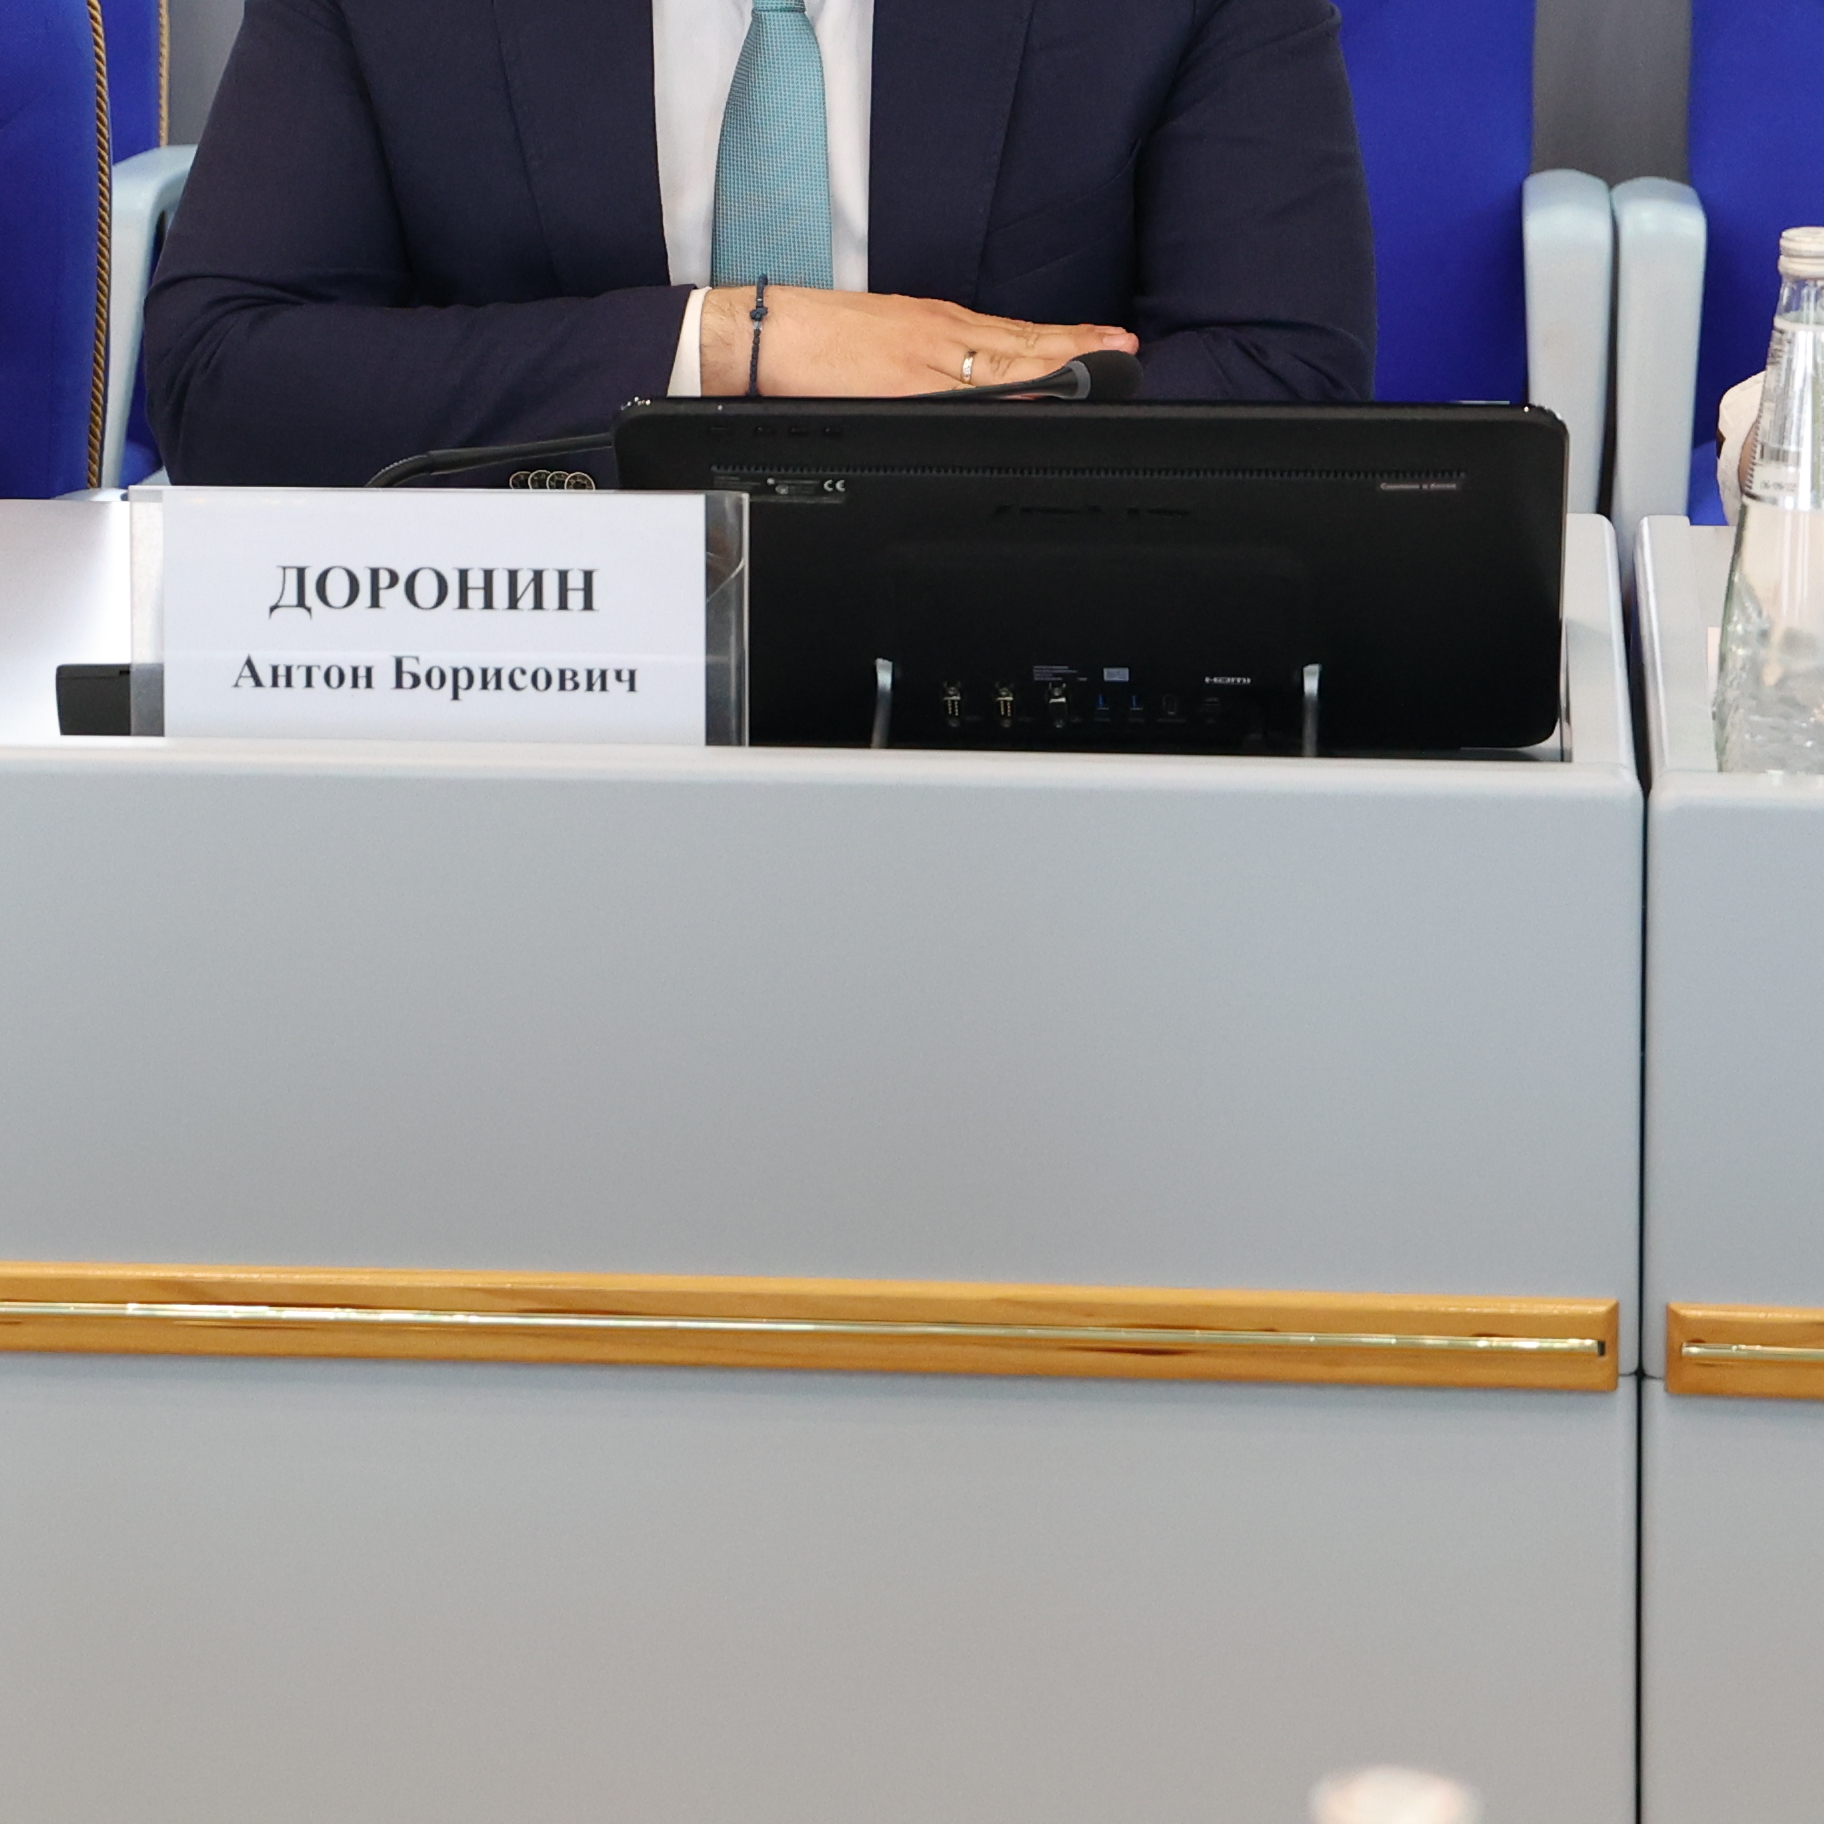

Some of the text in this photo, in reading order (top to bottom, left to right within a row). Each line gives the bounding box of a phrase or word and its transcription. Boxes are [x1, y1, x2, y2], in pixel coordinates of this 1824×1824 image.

[268, 564, 598, 619] ДОРОНИН
[232, 654, 638, 701] Антон Борисович
